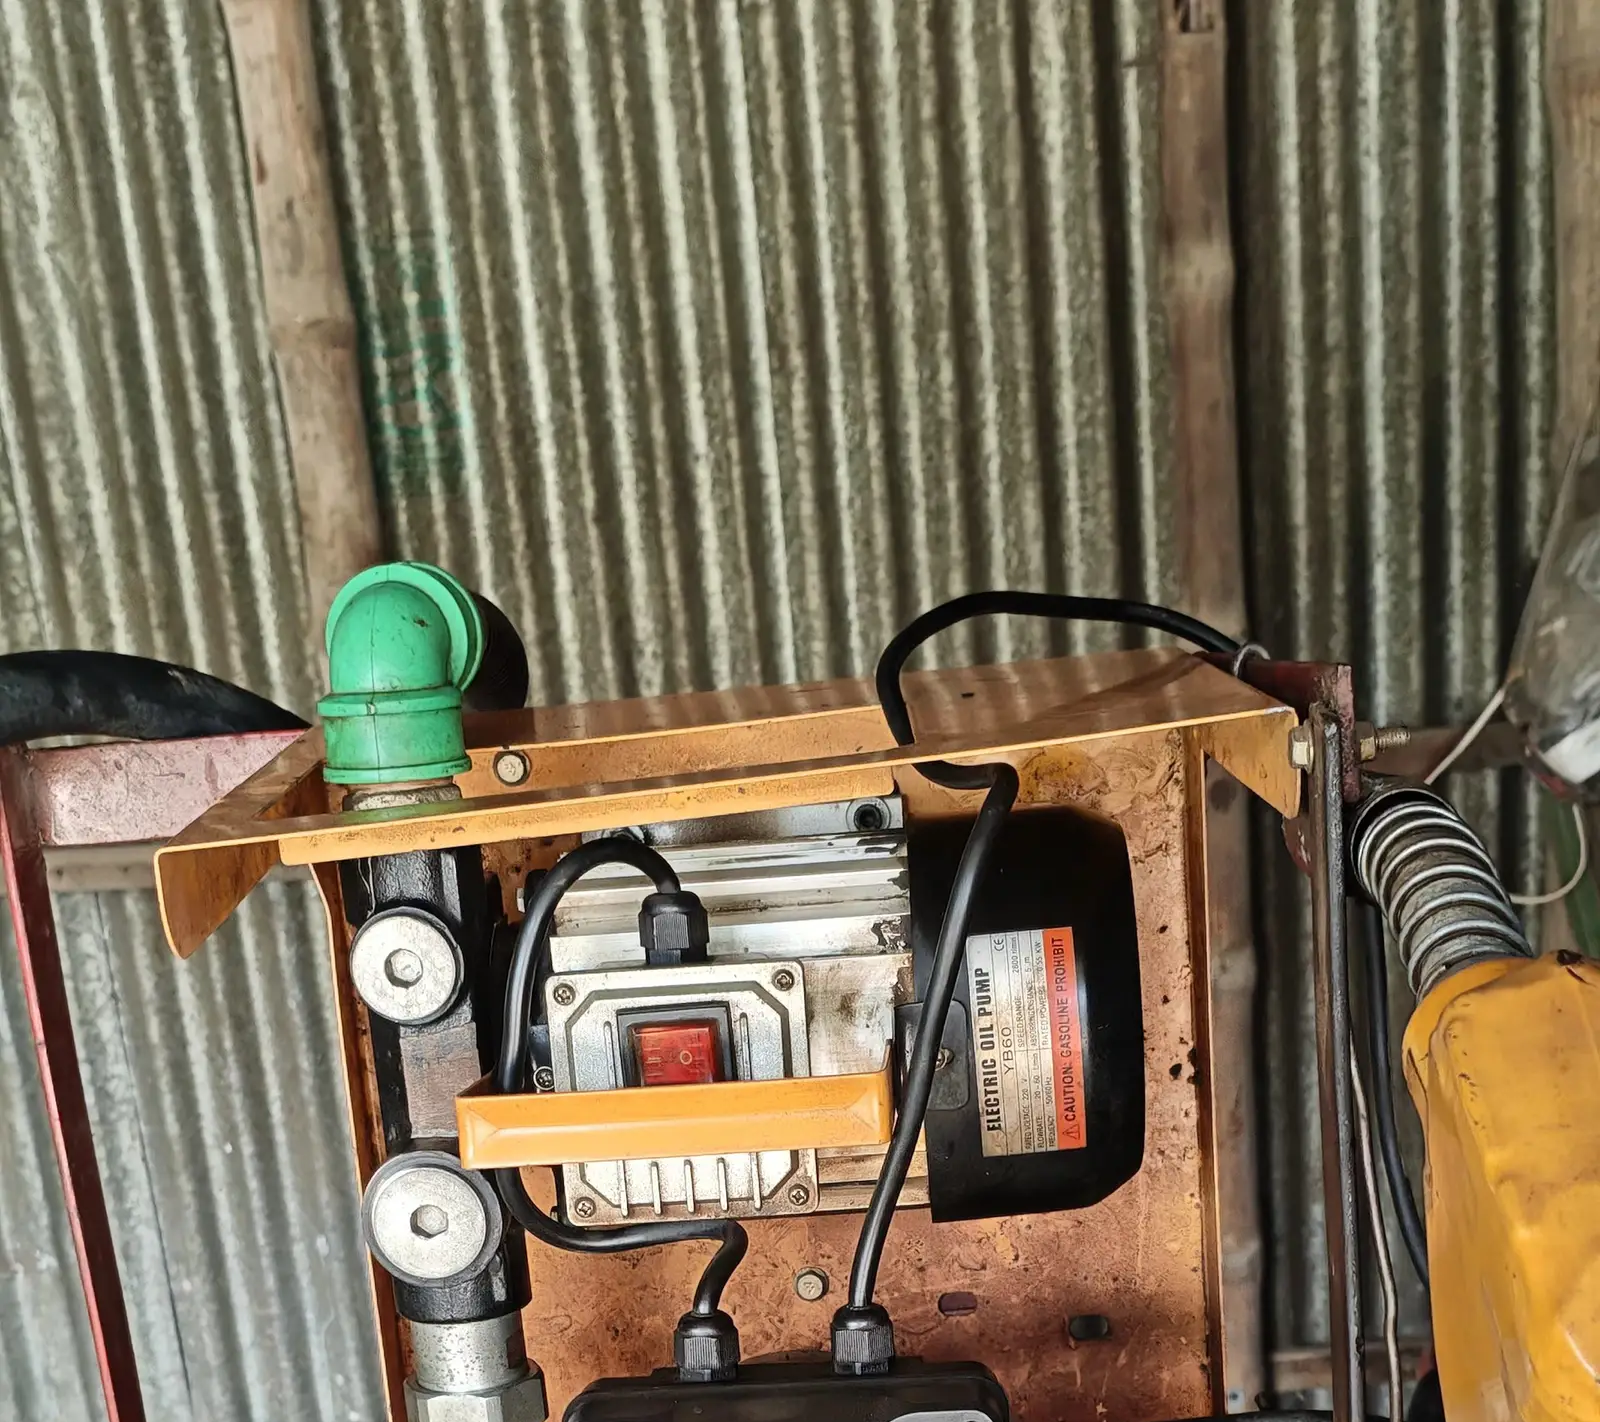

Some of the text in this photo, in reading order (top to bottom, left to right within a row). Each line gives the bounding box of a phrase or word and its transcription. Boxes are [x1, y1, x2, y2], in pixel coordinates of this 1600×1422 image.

[994, 938, 1004, 951] CE
[1051, 937, 1068, 992] PROHIBIT
[1015, 996, 1025, 1047] SPEED RANGE
[1056, 998, 1072, 1057] GASOLINE
[975, 968, 1000, 1131] ELECTRIC OIL PUMP
[1001, 1027, 1014, 1075] YB60
